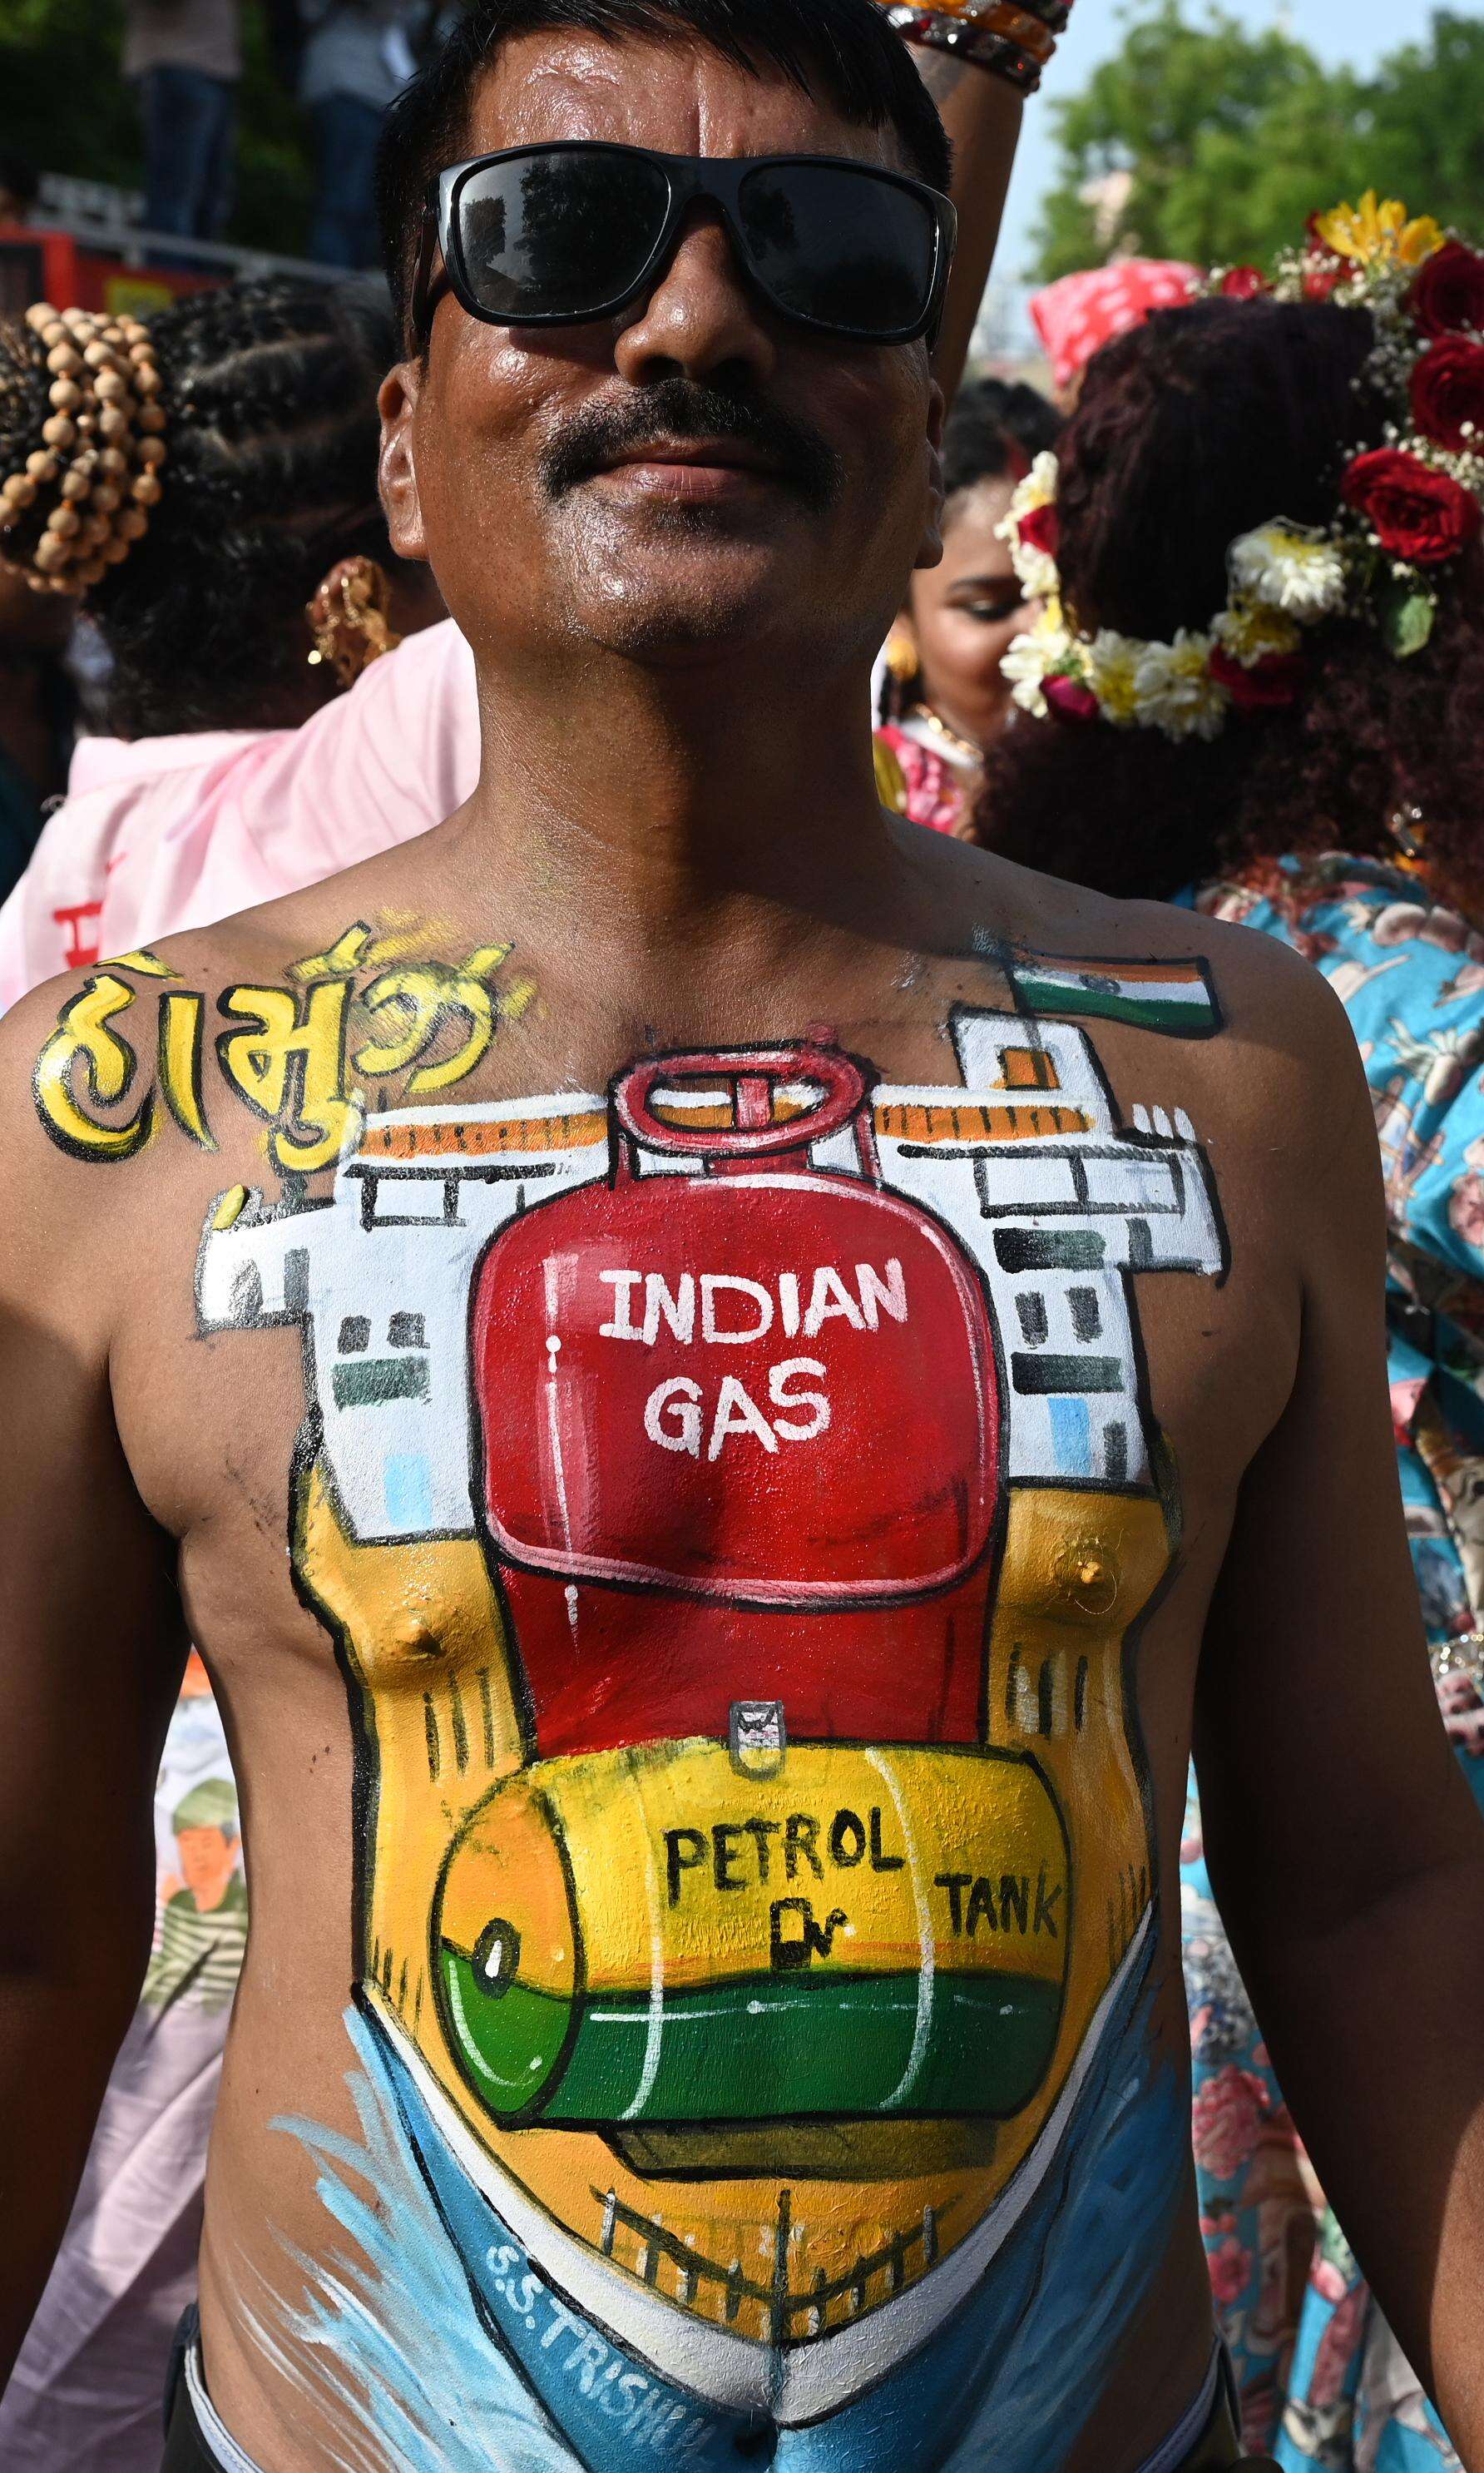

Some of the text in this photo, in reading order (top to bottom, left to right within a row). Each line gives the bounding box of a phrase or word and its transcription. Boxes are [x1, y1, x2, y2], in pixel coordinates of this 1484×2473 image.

[599, 1257, 908, 1346] INDIAN
[643, 1356, 831, 1462] GAS
[664, 1806, 1063, 1938] PETROL TANK
